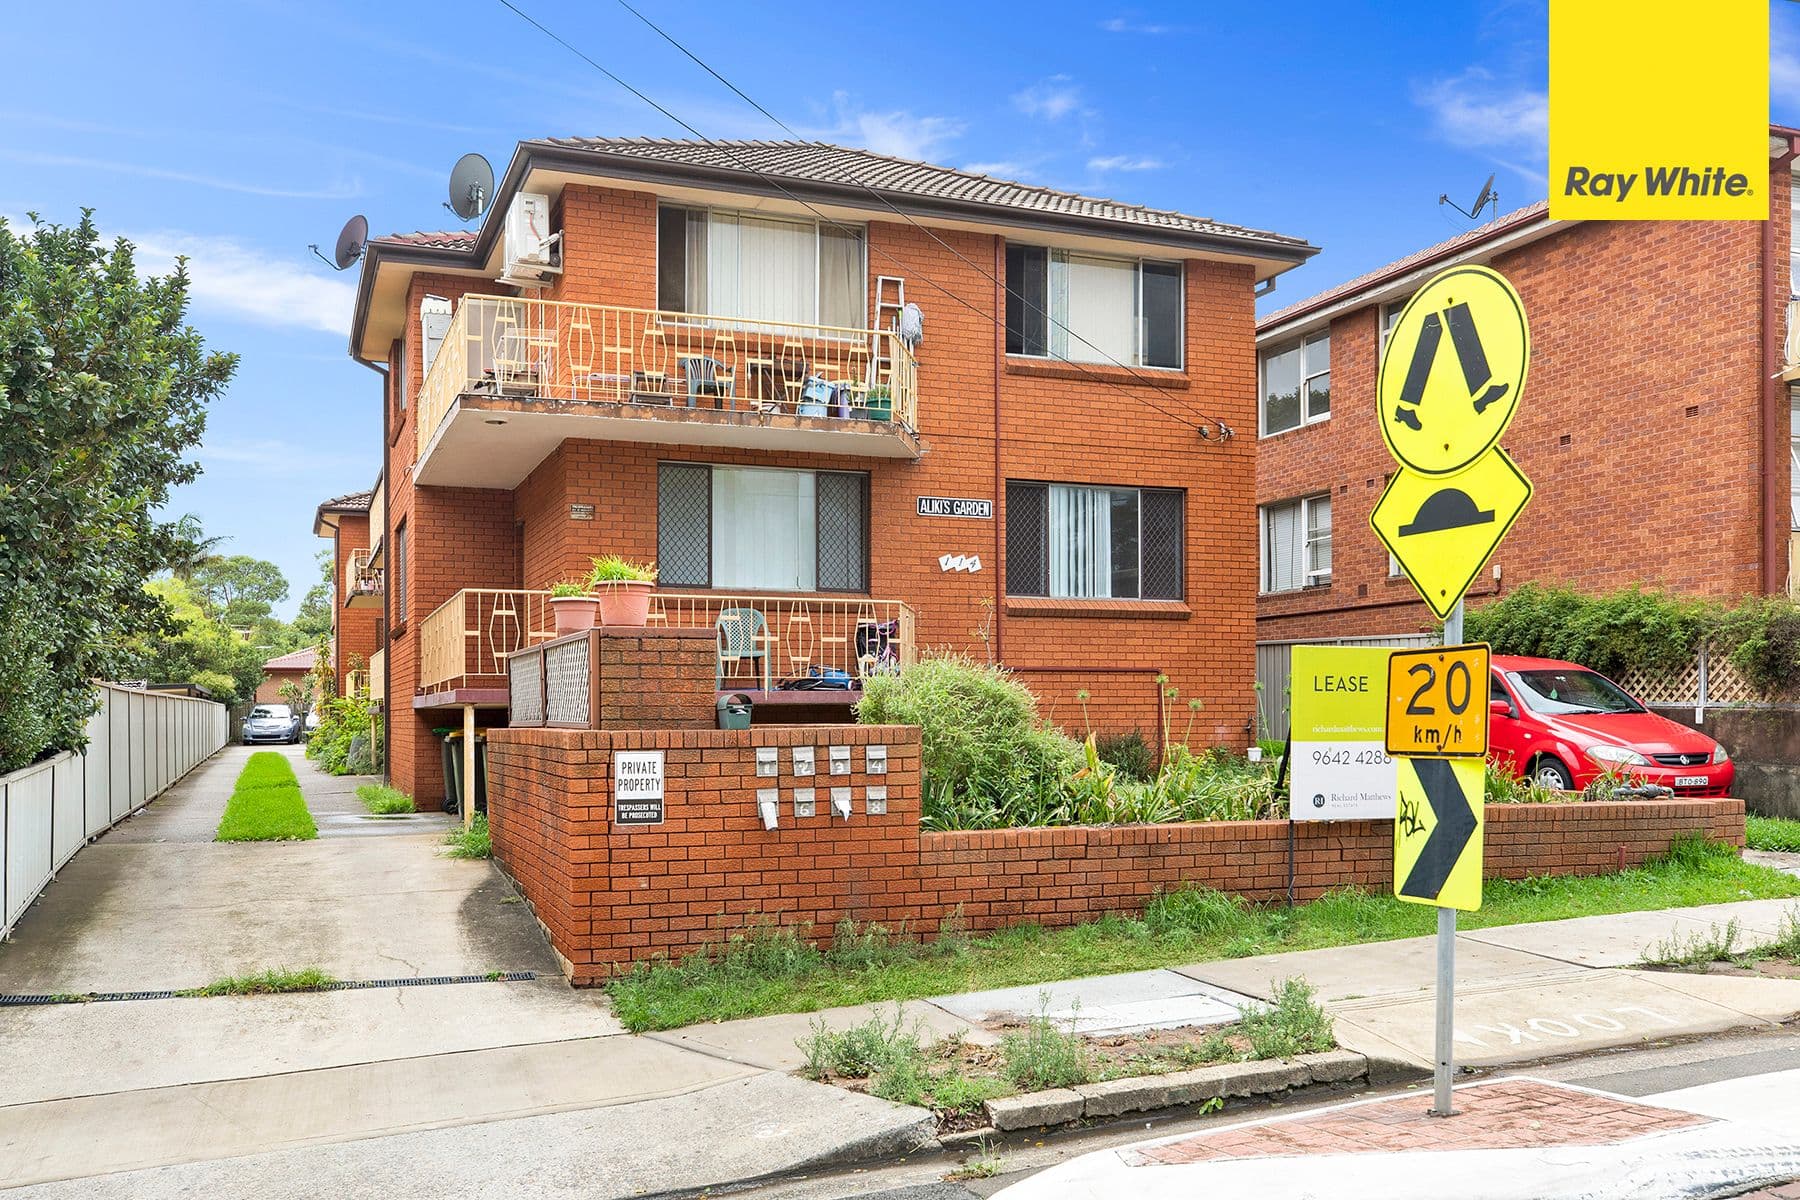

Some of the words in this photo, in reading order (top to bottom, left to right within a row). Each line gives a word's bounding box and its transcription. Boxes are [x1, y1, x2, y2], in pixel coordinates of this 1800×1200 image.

[920, 499, 950, 514] ALIKI'S
[953, 501, 990, 516] GARDEN
[1314, 675, 1368, 692] LEASE
[1406, 661, 1471, 715] 20
[1414, 724, 1462, 749] km/h
[1312, 750, 1350, 765] 9642
[622, 761, 657, 774] PRIVATE
[763, 763, 771, 774] 1
[799, 760, 811, 774] 2
[835, 762, 845, 773] 3
[871, 760, 883, 774] 4
[618, 778, 661, 791] PROPERTY
[1331, 793, 1358, 802] Richard
[1360, 792, 1392, 801] Matthews
[799, 803, 809, 815] 6
[872, 801, 880, 813] 8
